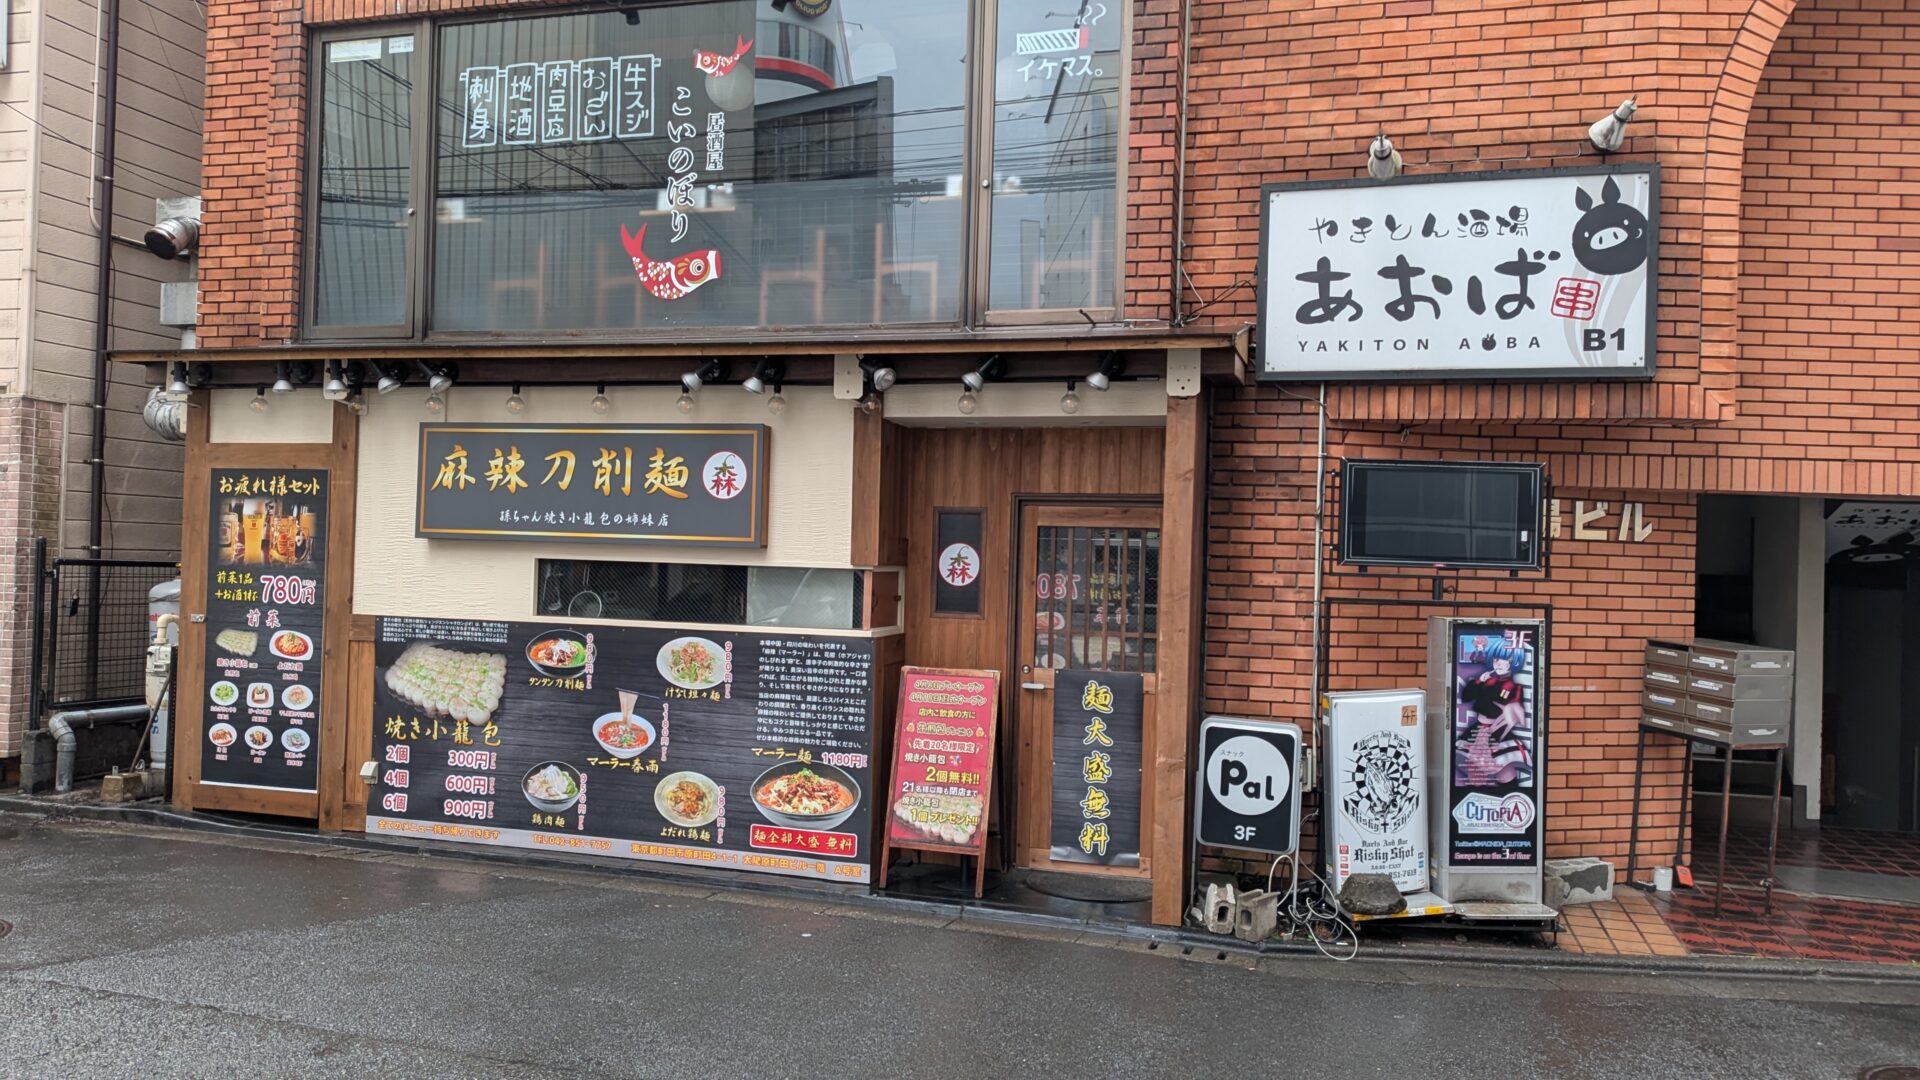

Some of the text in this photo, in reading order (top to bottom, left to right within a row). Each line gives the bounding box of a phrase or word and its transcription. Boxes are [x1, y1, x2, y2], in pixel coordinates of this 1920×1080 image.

[1017, 55, 1103, 82] イケマス。
[469, 76, 493, 139] 刺身
[509, 75, 532, 136] 地酒
[582, 67, 608, 136] おでん
[623, 63, 649, 131] 牛スジ
[706, 112, 725, 171] 居酒屋
[667, 86, 697, 243] こいのぼり
[1308, 205, 1529, 244] やきとん酒場
[1295, 247, 1561, 325] あおば
[1298, 338, 1429, 352] YAKITON
[1583, 328, 1625, 351] B1
[431, 444, 689, 499] 麻辣刀削麺
[219, 475, 320, 497] お疲れ様セット
[246, 608, 281, 628] 前菜
[1504, 631, 1533, 650] 3F
[724, 641, 733, 684] 980円
[661, 703, 669, 746] 1180円
[1402, 707, 1416, 724] 4F
[386, 744, 410, 763] 2個
[448, 750, 489, 770] 300円
[751, 747, 812, 764] マーラー麺
[821, 752, 863, 768] 1180円
[1220, 749, 1244, 758] スナック
[587, 757, 659, 774] マーラー春雨
[1078, 679, 1114, 855] 麺大盛無料
[384, 769, 409, 788] 4個
[445, 775, 488, 795] 600円
[1220, 758, 1274, 801] Pal
[383, 793, 408, 812] 6個
[578, 773, 587, 815] 950円
[444, 799, 487, 819] 900円
[717, 786, 725, 828] 980円
[1351, 807, 1379, 832] Risky
[1233, 825, 1257, 841] 3F
[1382, 839, 1395, 847] And
[1353, 845, 1414, 863] Risky Shot
